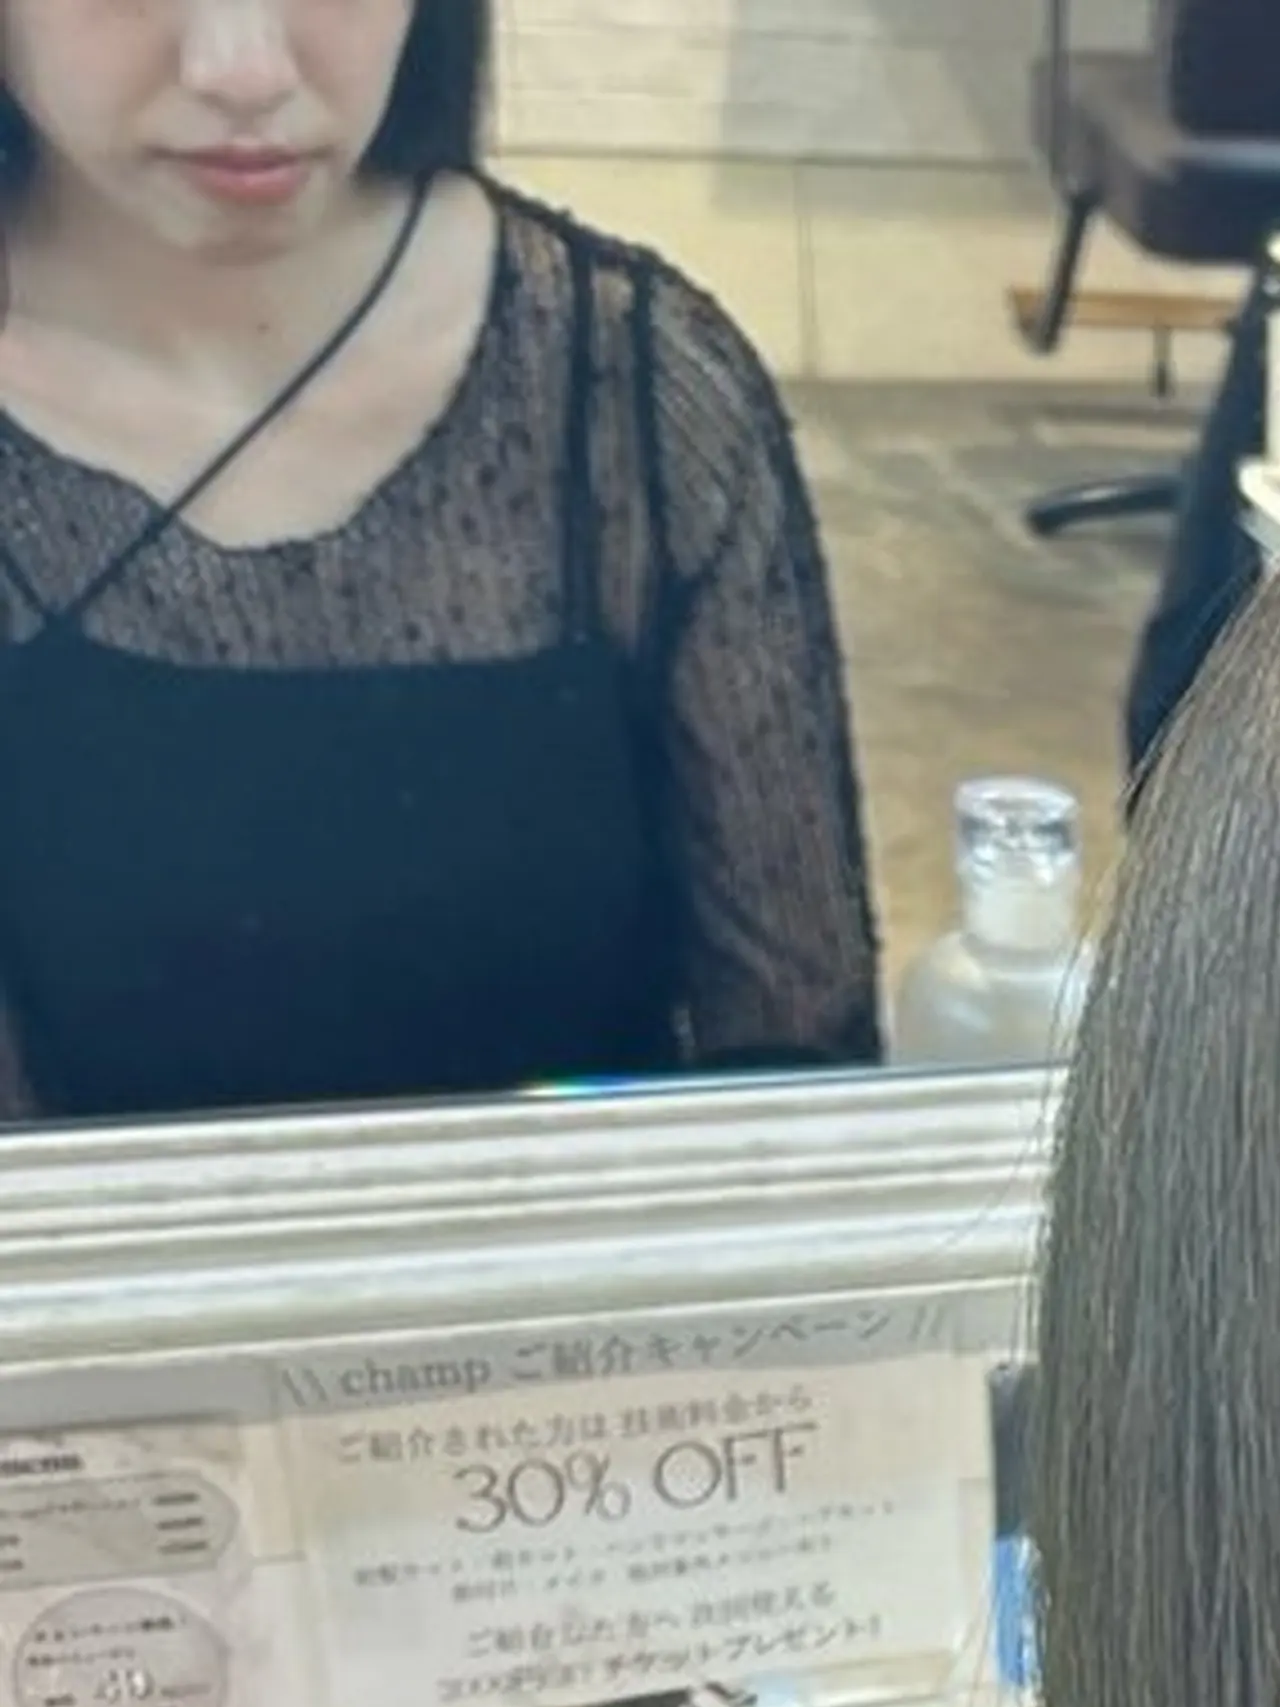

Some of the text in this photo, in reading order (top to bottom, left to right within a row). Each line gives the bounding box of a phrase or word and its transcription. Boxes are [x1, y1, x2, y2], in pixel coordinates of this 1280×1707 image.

[339, 1351, 491, 1398] champ
[511, 1308, 894, 1383] ご紹介キャンペーン
[453, 1423, 819, 1534] 30% OFF
